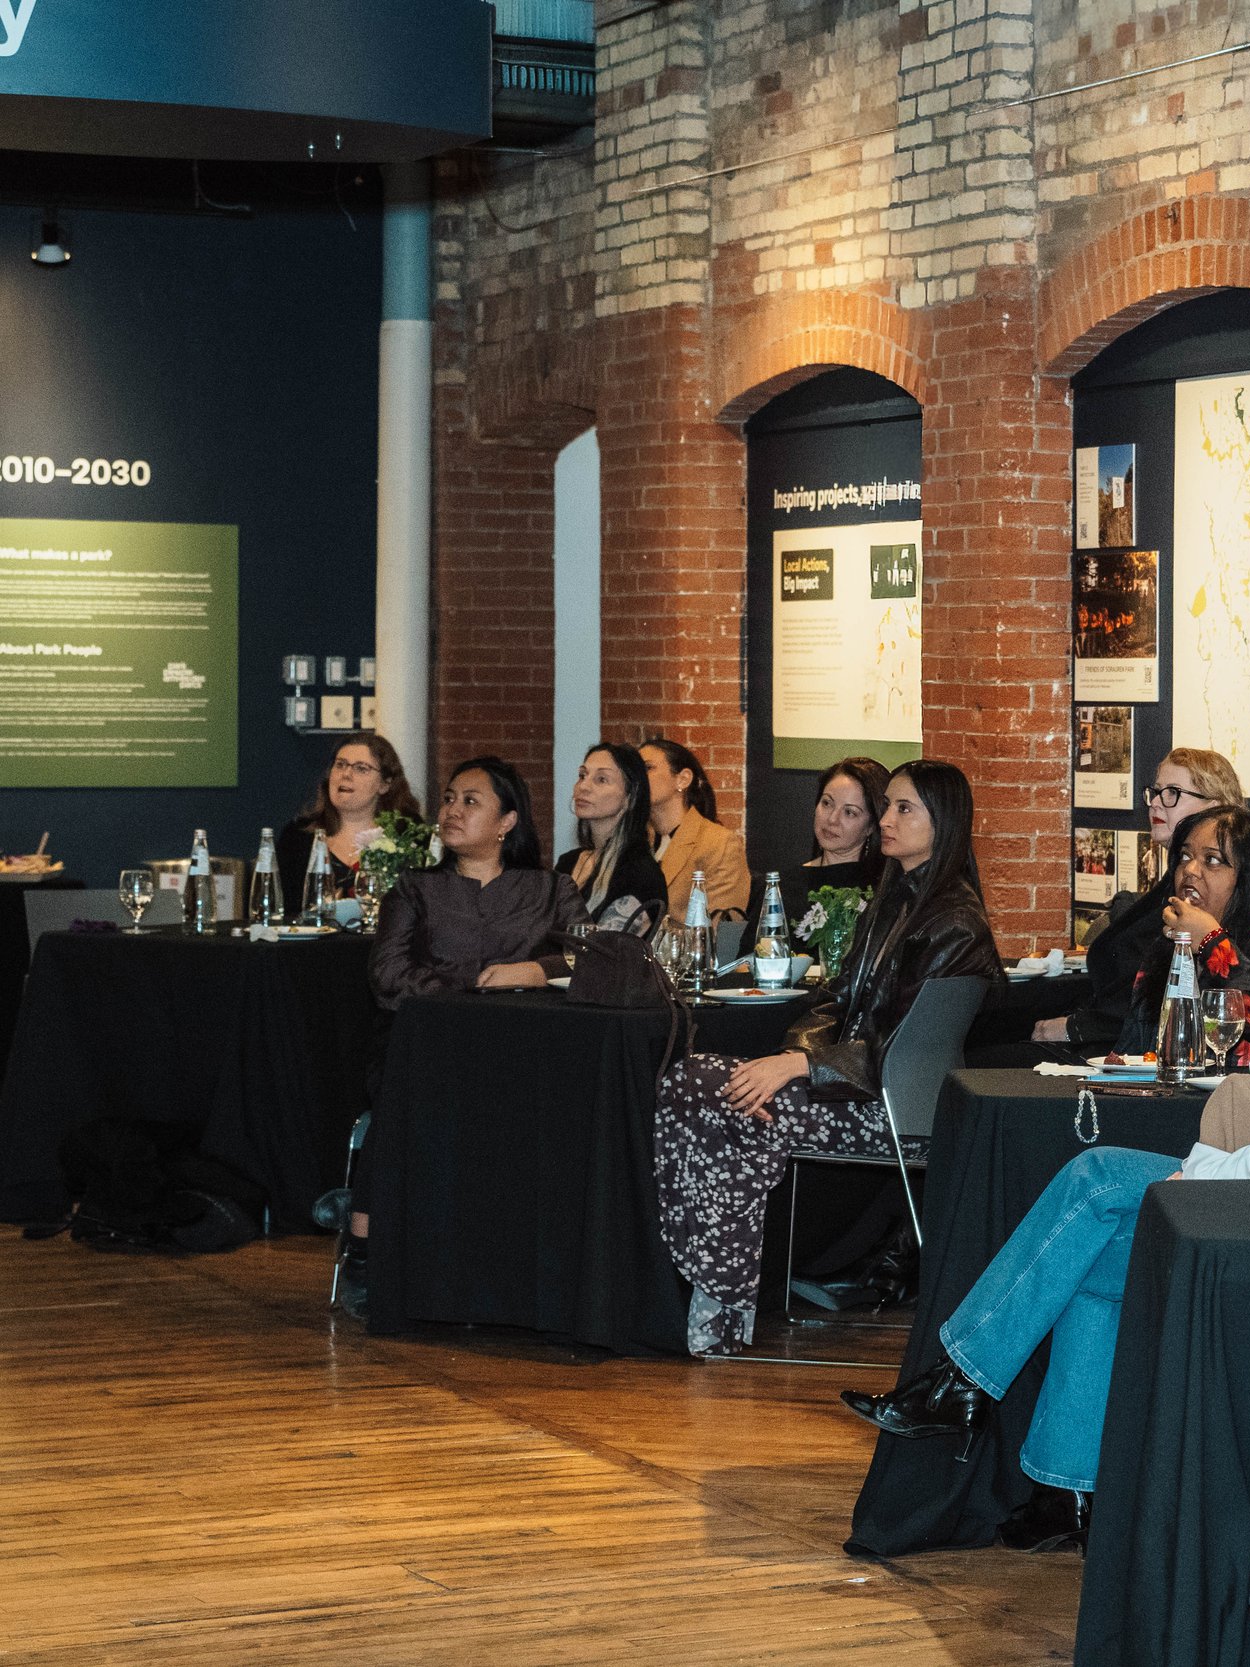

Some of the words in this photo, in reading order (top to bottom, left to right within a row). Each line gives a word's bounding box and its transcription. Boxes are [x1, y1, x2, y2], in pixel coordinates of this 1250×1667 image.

[0, 455, 151, 486] 010–2030
[774, 487, 817, 514] Inspiring
[783, 558, 801, 573] Local
[801, 556, 830, 574] Actions,
[783, 576, 796, 594] Big
[795, 575, 820, 593] Impact
